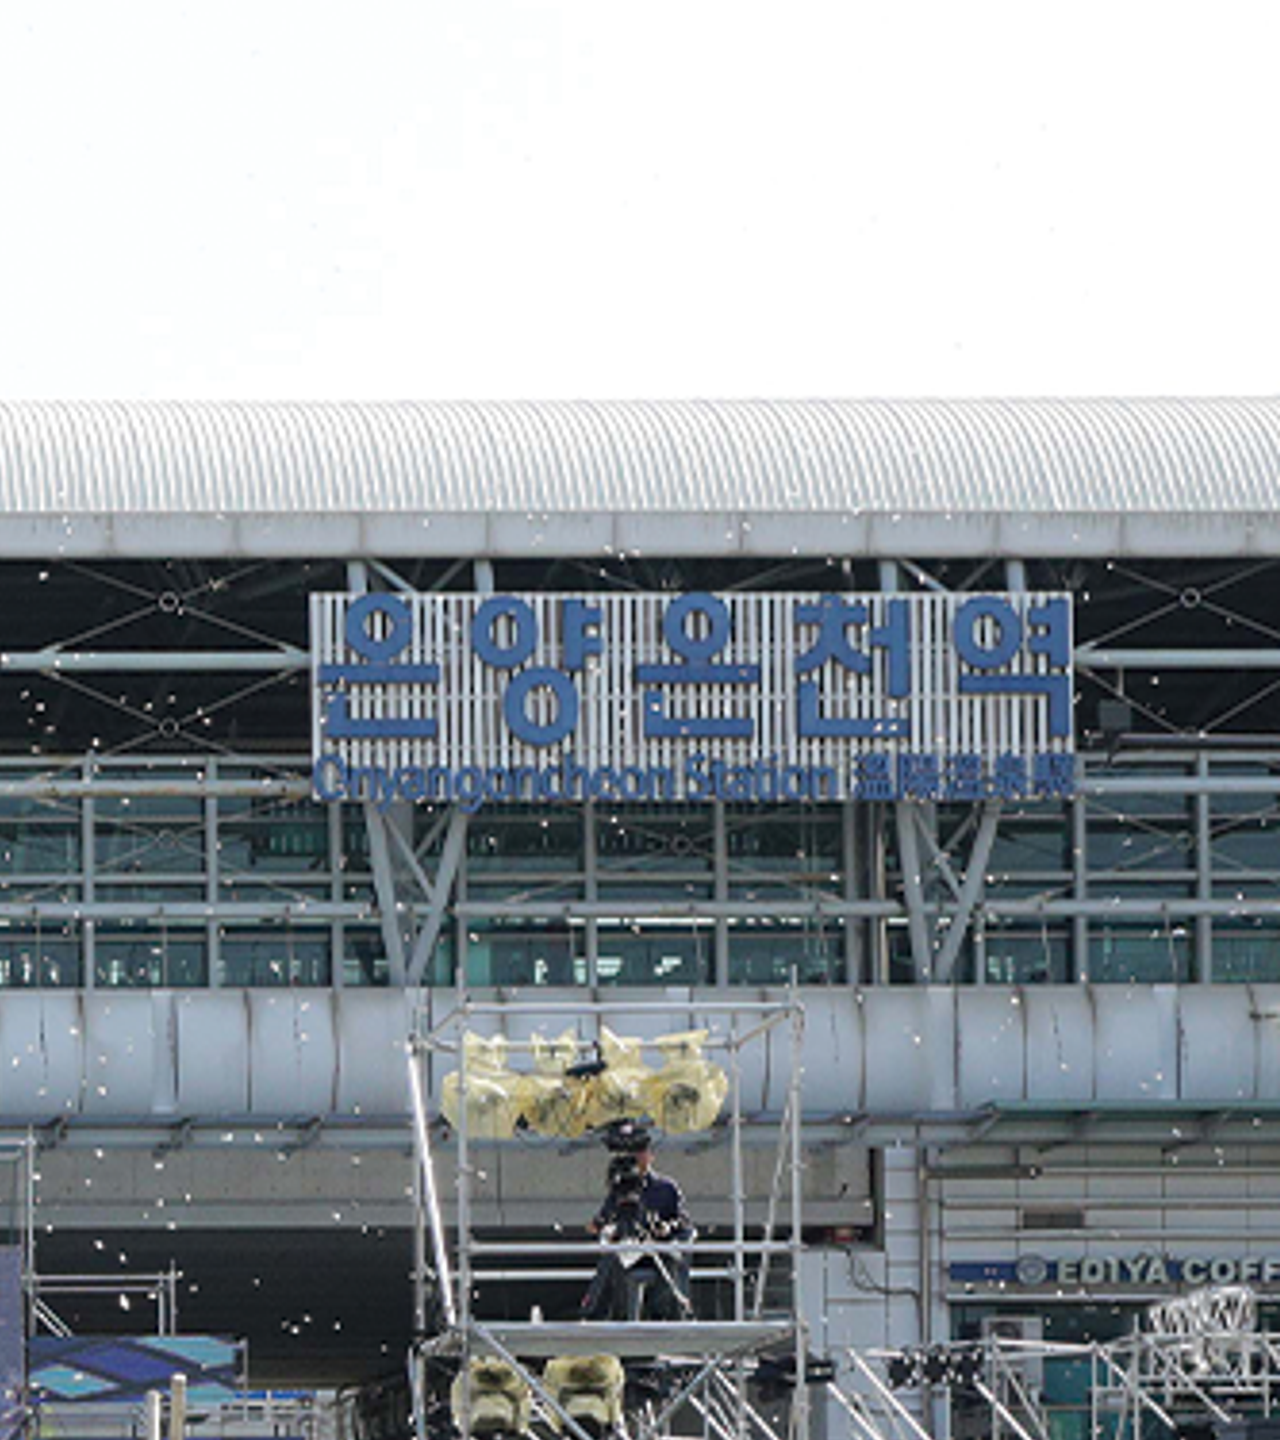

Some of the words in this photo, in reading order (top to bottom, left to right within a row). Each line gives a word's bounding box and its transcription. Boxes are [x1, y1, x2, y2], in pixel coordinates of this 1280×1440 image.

[319, 592, 1070, 745] 온양온천역
[312, 752, 675, 813] Onyangoncheon
[686, 751, 839, 800] Station
[1057, 1256, 1169, 1284] EDIYA
